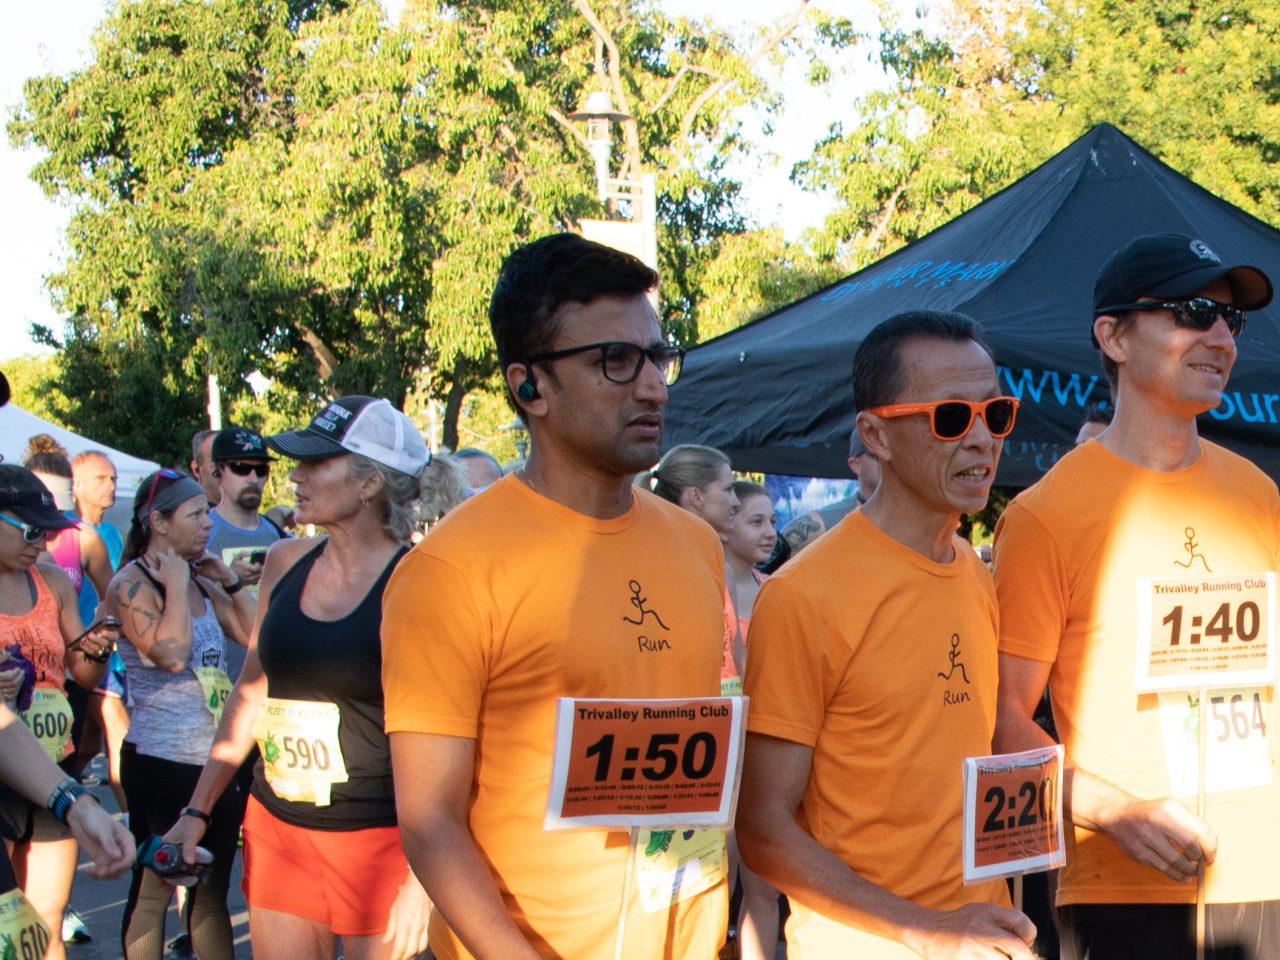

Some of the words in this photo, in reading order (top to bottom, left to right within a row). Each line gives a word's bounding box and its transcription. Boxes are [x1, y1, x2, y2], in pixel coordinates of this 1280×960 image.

[924, 259, 1016, 281] MARK
[1153, 583, 1200, 594] Trivalley
[1202, 581, 1242, 592] Running
[1244, 579, 1266, 589] Club
[1162, 600, 1260, 646] 1:40
[637, 635, 671, 652] Run
[943, 690, 971, 706] Run
[33, 711, 68, 739] 600
[578, 708, 638, 722] Trivalley
[643, 706, 696, 721] Running
[700, 705, 729, 717] Club
[1211, 692, 1267, 743] 564
[283, 736, 330, 771] 590
[585, 731, 717, 783] 1:50
[983, 778, 1054, 833] 2:20
